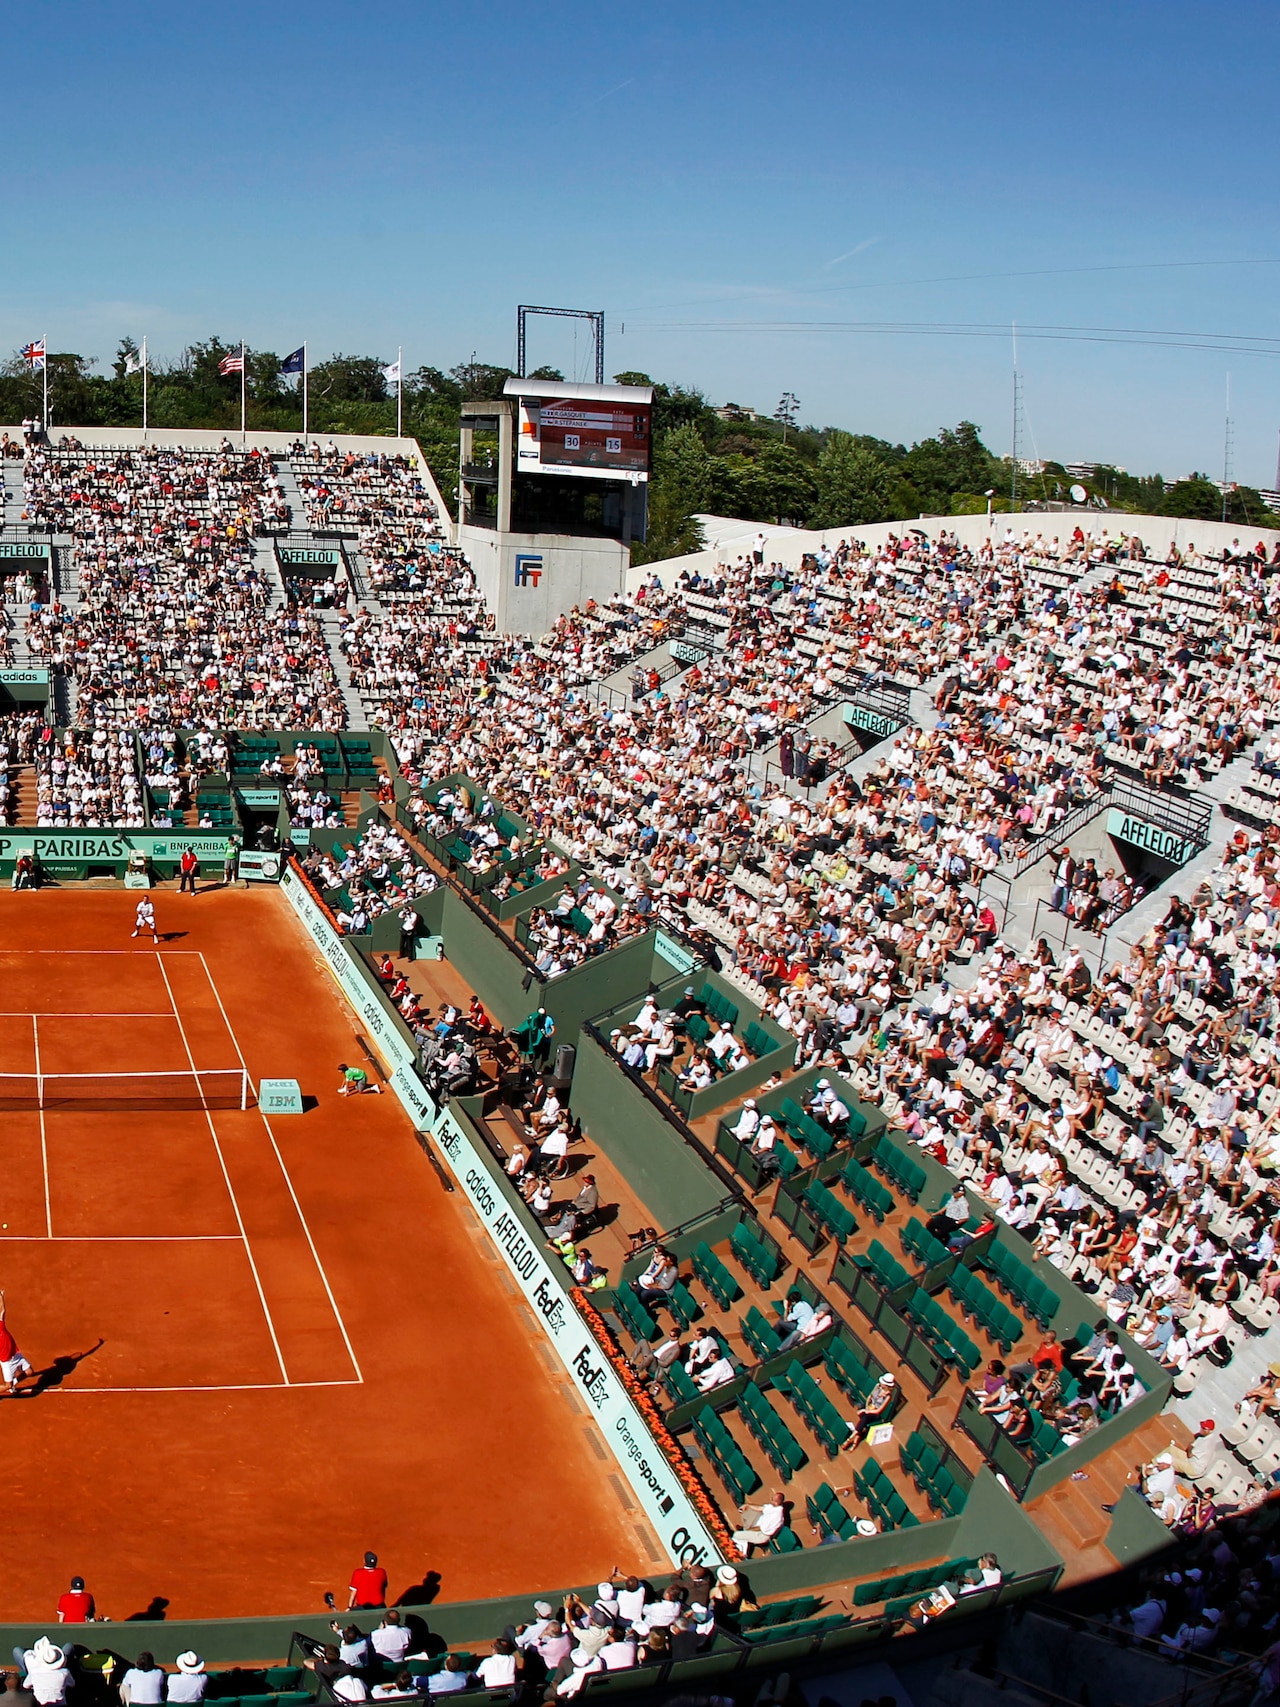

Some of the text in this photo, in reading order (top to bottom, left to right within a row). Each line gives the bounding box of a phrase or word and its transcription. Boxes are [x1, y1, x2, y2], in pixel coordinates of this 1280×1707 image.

[566, 437, 579, 447] 30
[607, 440, 620, 450] 15
[282, 550, 333, 563] AFFLELOU
[515, 554, 543, 587] FFT
[3, 672, 38, 681] adidas
[33, 838, 123, 857] PARIBAS
[170, 842, 228, 851] BNP PARIBA
[1120, 817, 1185, 862] AFFLELOU
[312, 921, 328, 947] adidas
[326, 942, 350, 976] AFFLELOU
[363, 1003, 384, 1034] adidas
[269, 1096, 296, 1107] IBM
[395, 1067, 424, 1110] Orange sport
[437, 1119, 462, 1162] FedEx
[465, 1169, 496, 1216] adidas
[493, 1212, 539, 1281] AFFLELOU
[533, 1277, 566, 1335] FedEx
[572, 1344, 609, 1409] FedEx
[615, 1416, 666, 1500] Orange sport
[670, 1526, 710, 1566] adi
